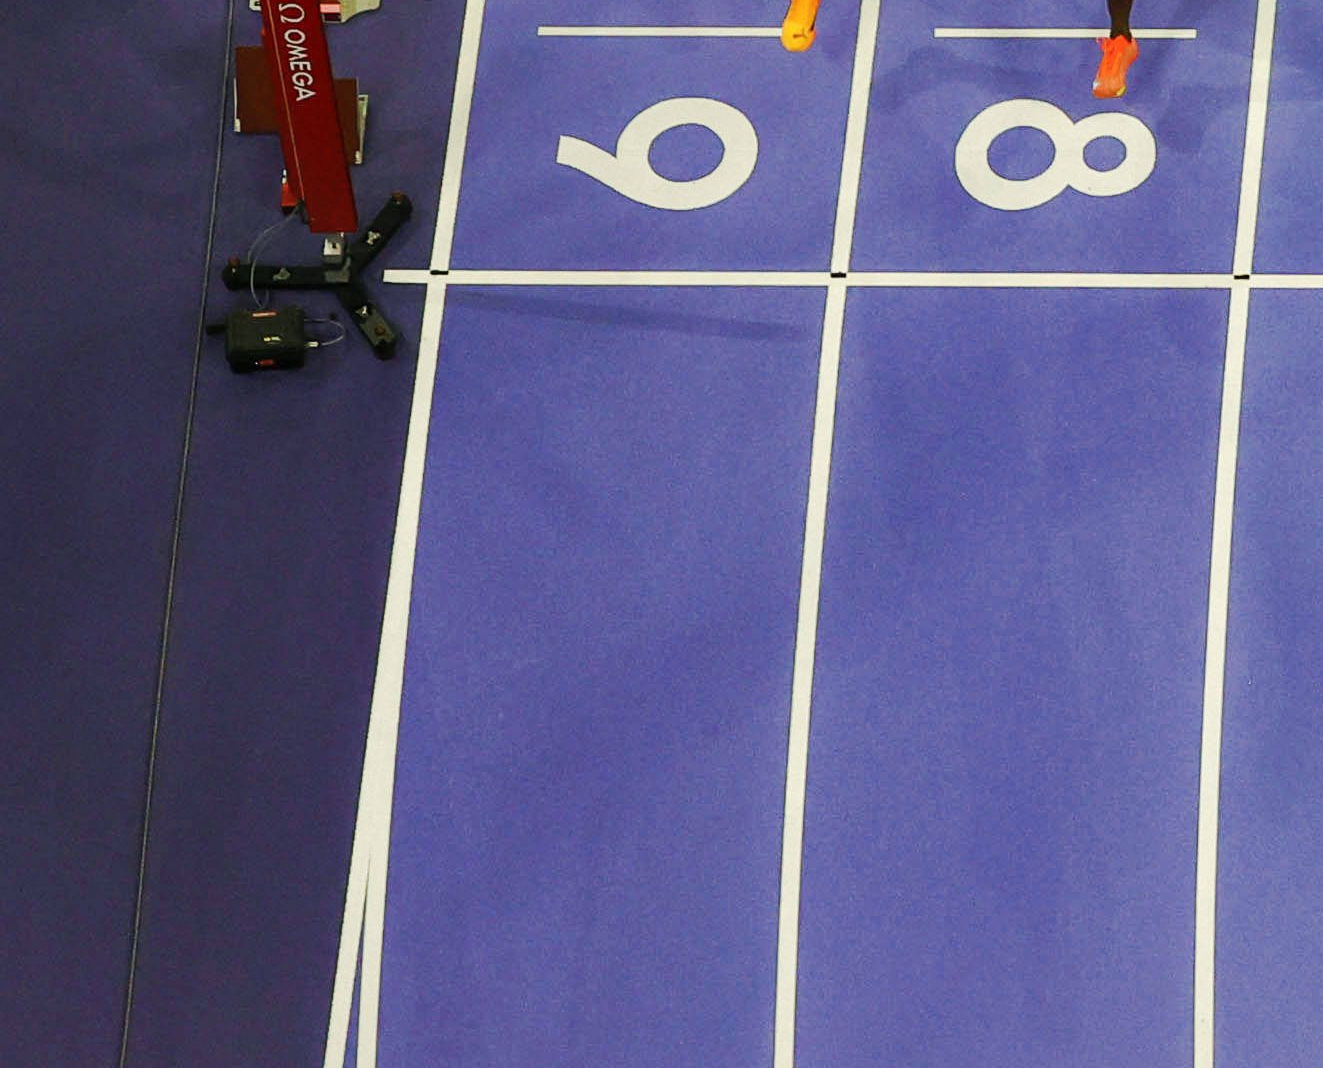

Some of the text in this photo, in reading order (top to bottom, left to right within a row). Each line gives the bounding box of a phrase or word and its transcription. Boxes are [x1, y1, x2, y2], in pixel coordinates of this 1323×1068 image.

[283, 28, 317, 102] OMEGA
[557, 97, 759, 211] 9
[955, 98, 1156, 211] 8
